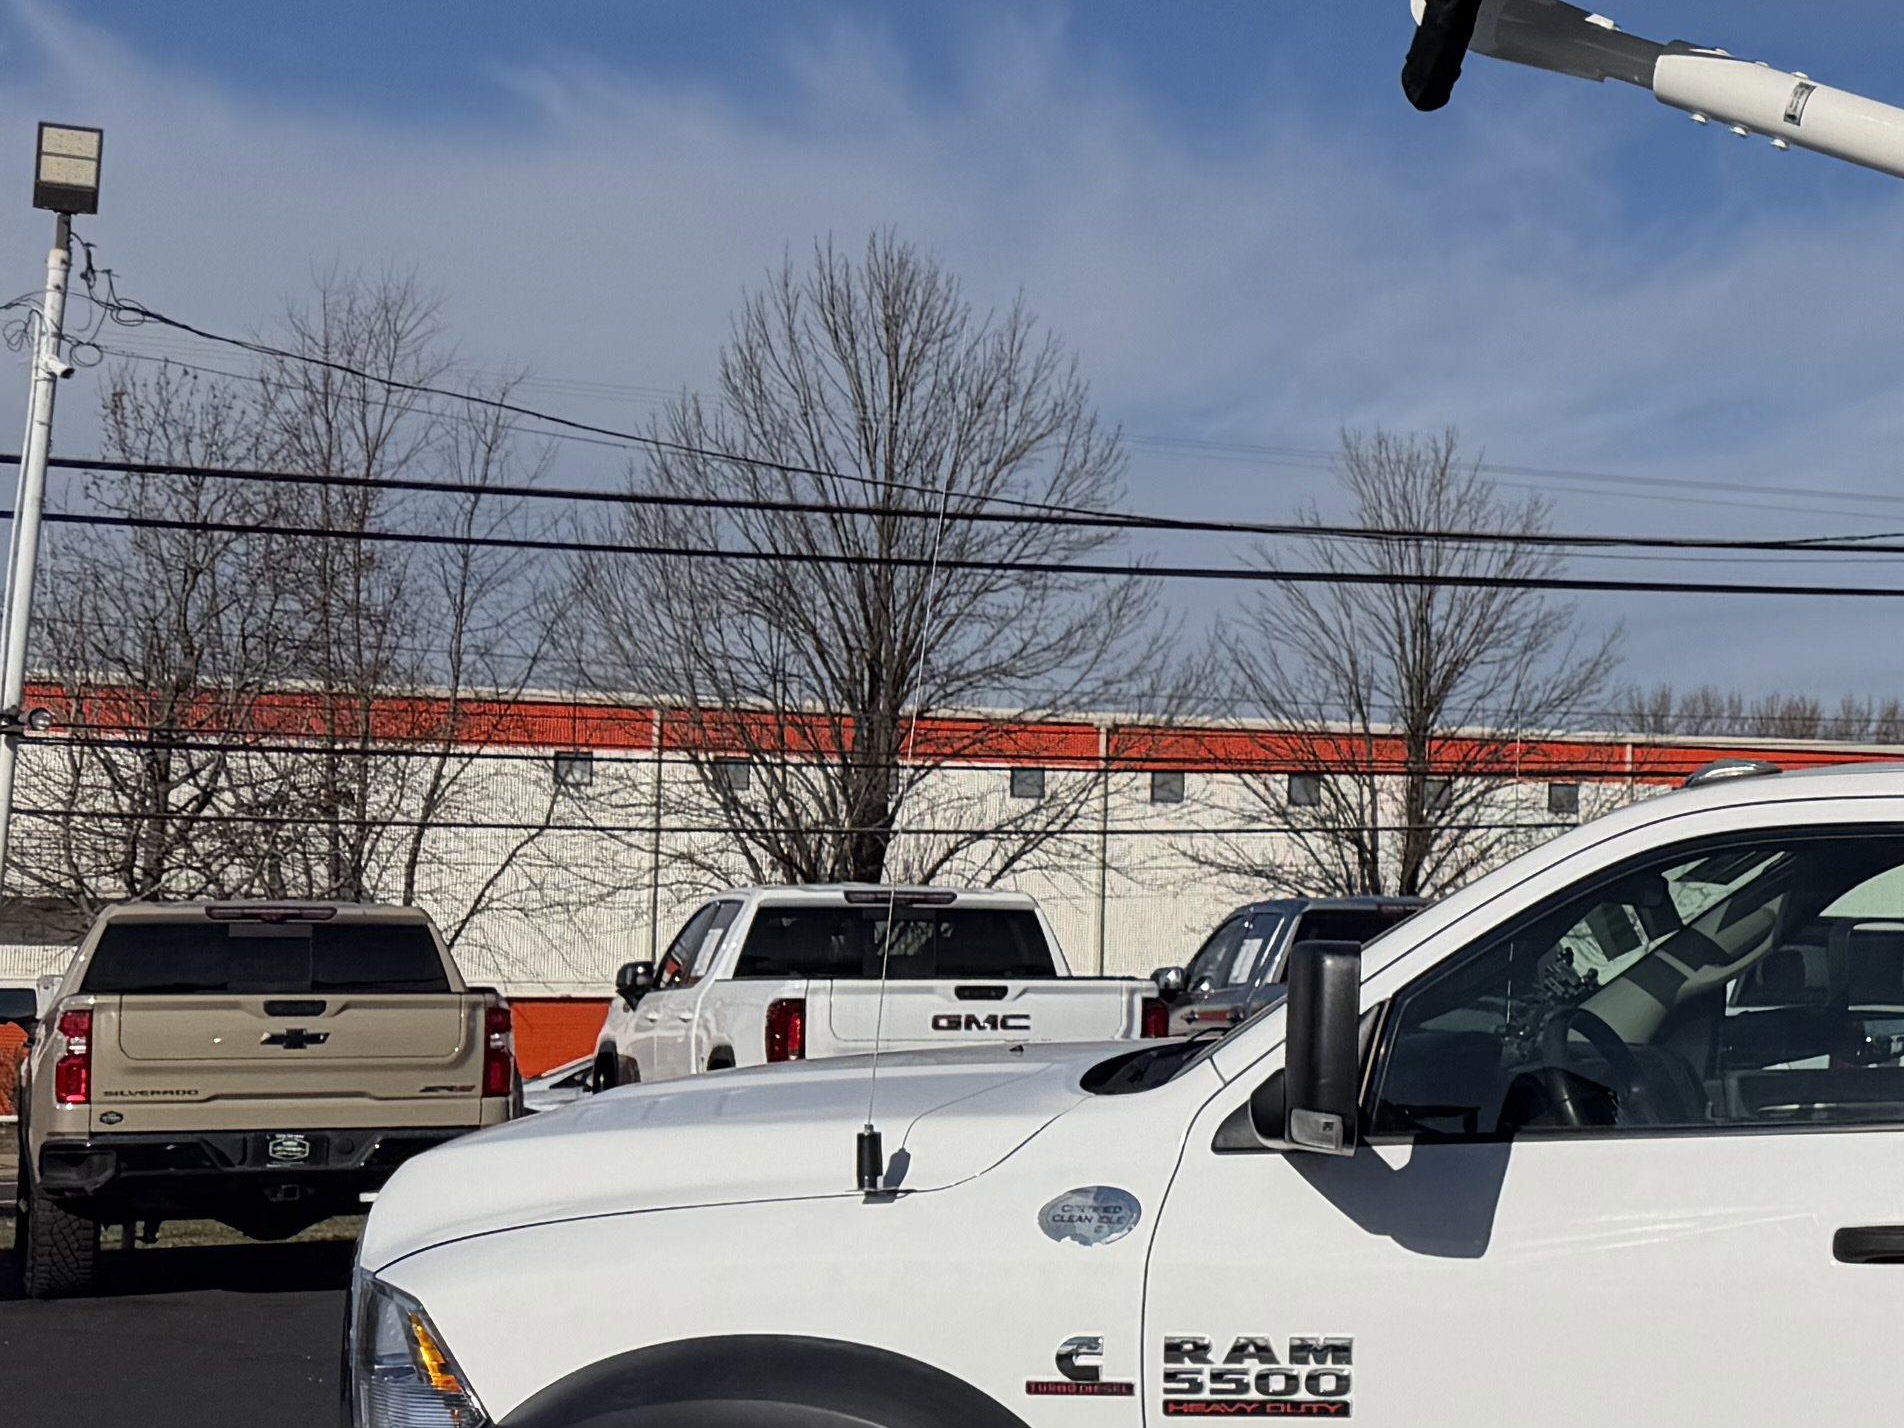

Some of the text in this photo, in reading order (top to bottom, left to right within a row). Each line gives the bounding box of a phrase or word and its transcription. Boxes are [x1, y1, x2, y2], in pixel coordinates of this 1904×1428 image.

[931, 1014, 1031, 1031] GMC
[103, 1088, 199, 1098] SILVERADO
[1052, 1213, 1093, 1223] CLEAN
[1163, 1336, 1354, 1365] RAM
[1163, 1367, 1351, 1397] 5500
[1030, 1383, 1077, 1394] TURBO
[1168, 1402, 1343, 1414] HEAVY DUTY
